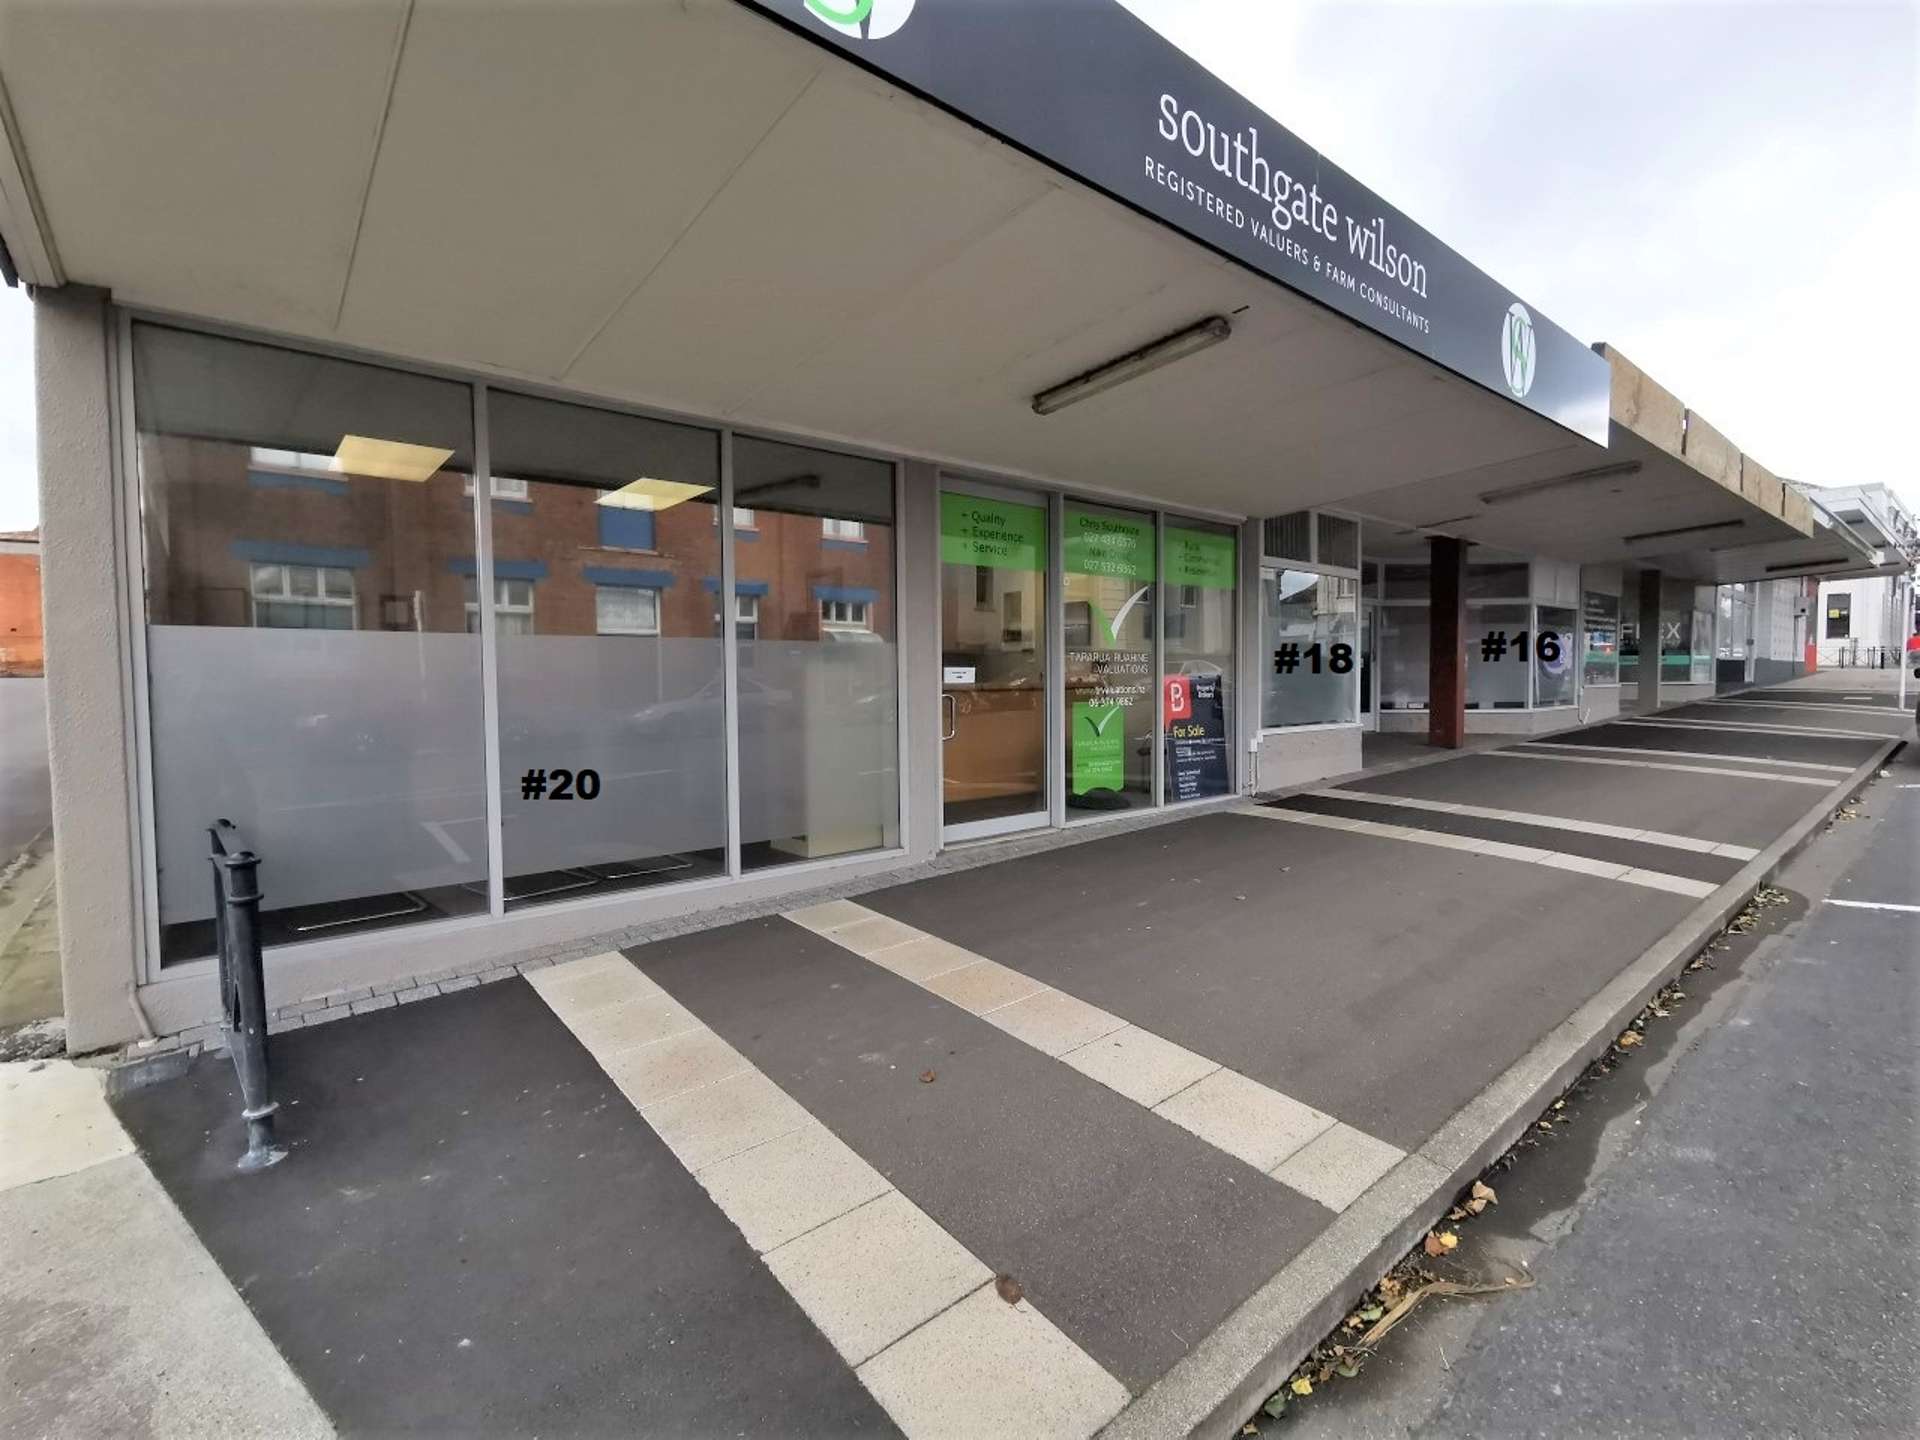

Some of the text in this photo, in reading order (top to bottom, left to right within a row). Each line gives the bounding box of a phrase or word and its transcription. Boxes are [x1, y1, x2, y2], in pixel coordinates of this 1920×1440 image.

[1159, 94, 1428, 299] southgate wilson
[1145, 155, 1430, 334] REGISTERED VALUERS & FARM CONSULTANTS
[971, 510, 1007, 527] Quality
[972, 526, 1025, 543] Experience
[1173, 723, 1205, 739] For Sale
